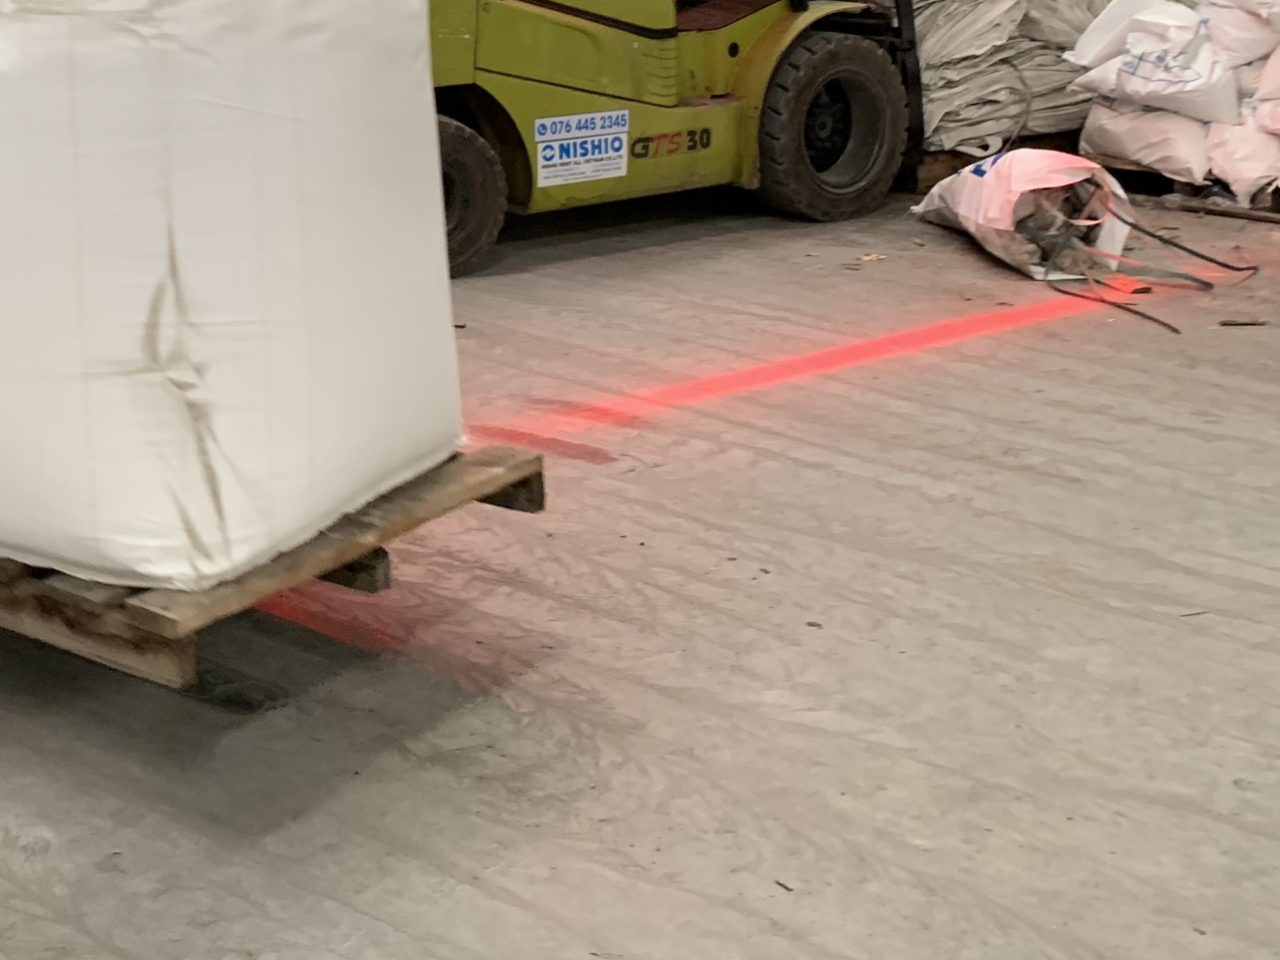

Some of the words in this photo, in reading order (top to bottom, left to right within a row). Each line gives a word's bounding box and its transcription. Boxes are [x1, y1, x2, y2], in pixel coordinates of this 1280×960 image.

[550, 120, 572, 135] 076
[575, 117, 597, 131] 445
[600, 114, 627, 129] 2345
[558, 136, 623, 159] NISHIO
[686, 128, 711, 150] 30
